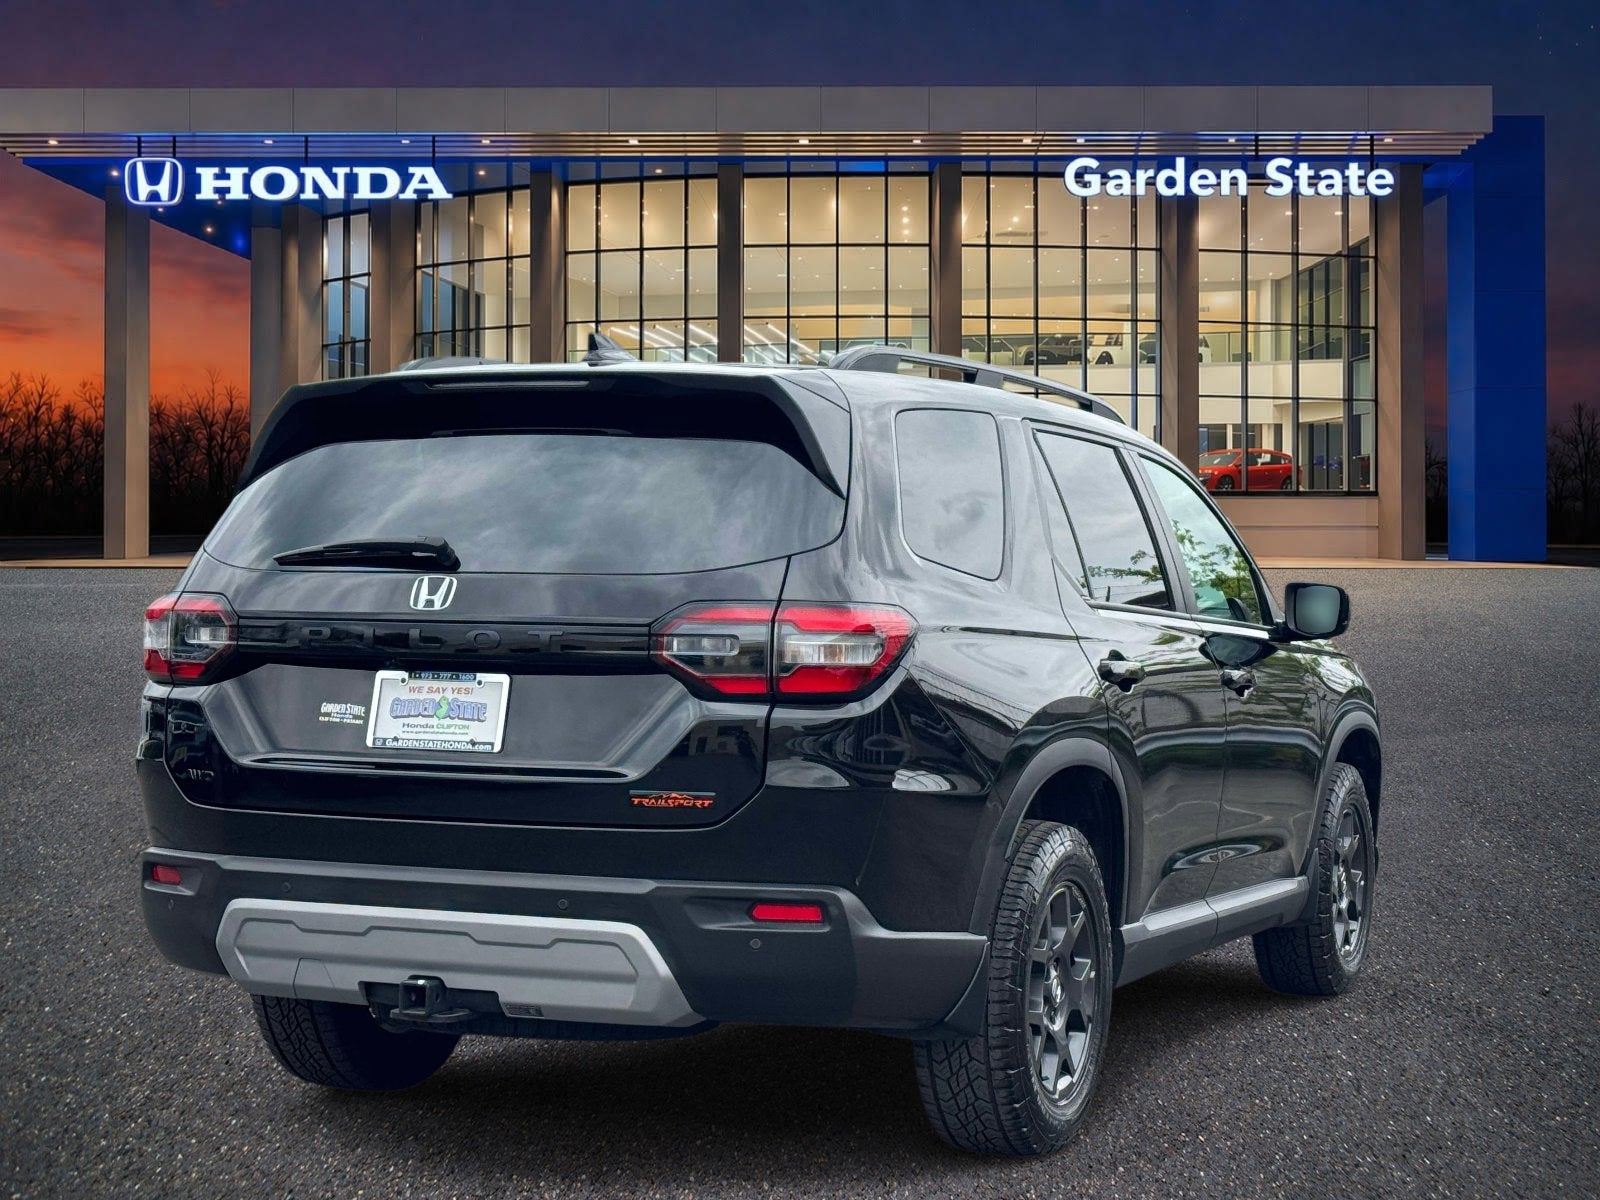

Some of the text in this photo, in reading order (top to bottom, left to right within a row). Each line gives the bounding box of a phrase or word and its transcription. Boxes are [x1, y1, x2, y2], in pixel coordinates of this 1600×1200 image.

[195, 166, 453, 200] HONDA
[1064, 157, 1395, 198] Garden State
[301, 626, 565, 653] PILOT
[408, 686, 474, 695] WE SAY YES!
[320, 702, 366, 717] GARDEN STATE
[390, 696, 488, 723] GARDEN STATE
[630, 797, 713, 808] TRAILSPORT
